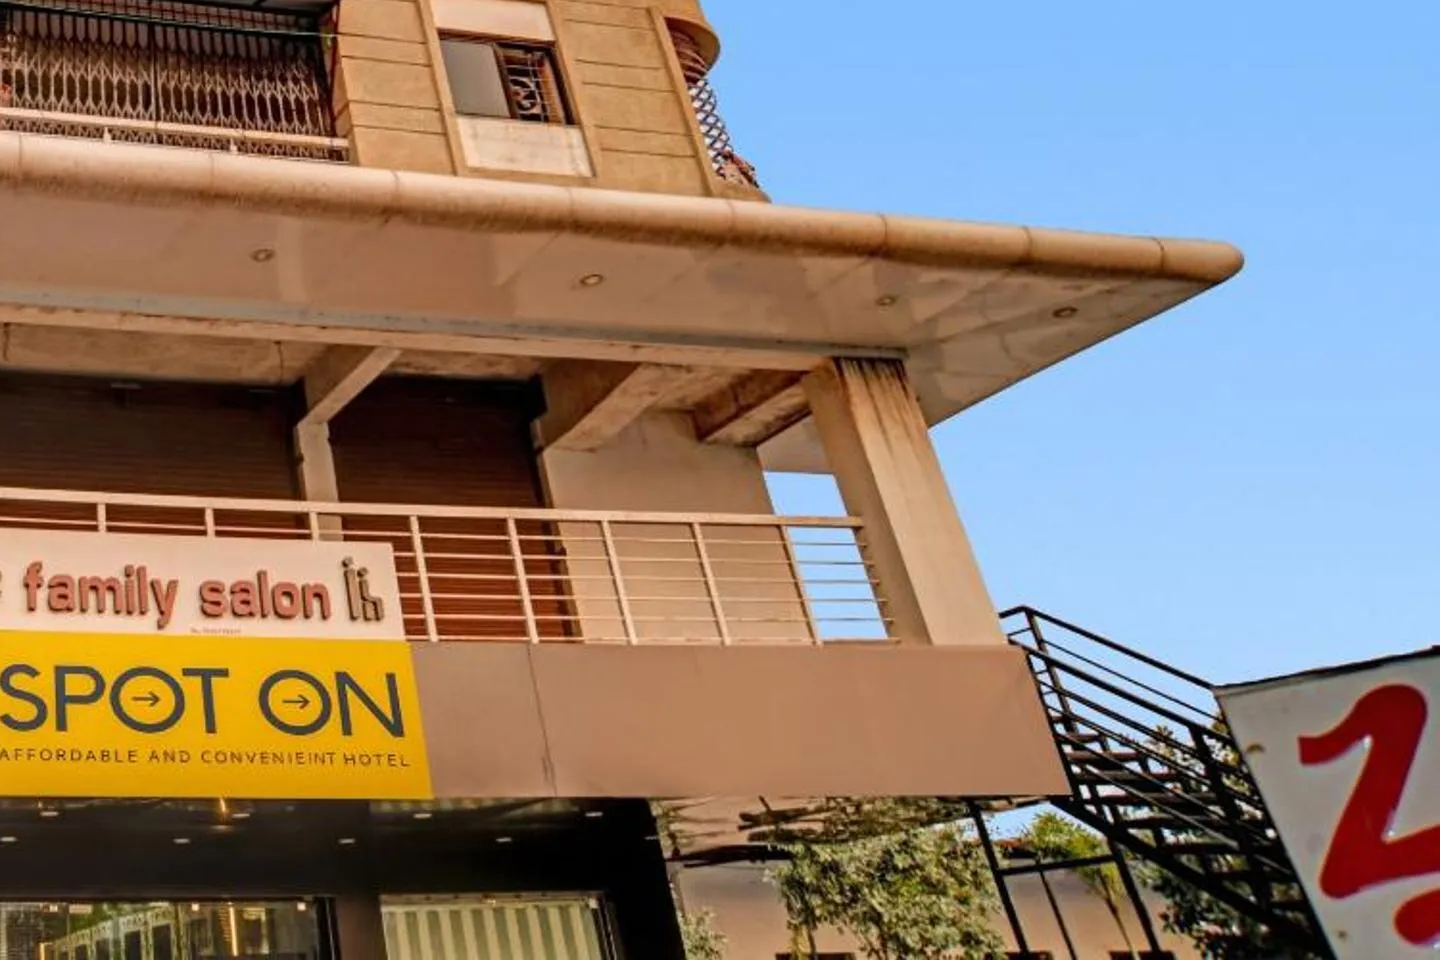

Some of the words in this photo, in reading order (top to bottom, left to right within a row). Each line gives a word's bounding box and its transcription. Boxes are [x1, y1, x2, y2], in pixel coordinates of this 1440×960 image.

[23, 560, 179, 630] family
[198, 570, 332, 620] salon
[258, 669, 405, 738] ON
[148, 748, 192, 764] AND
[343, 752, 411, 768] HOTEL
